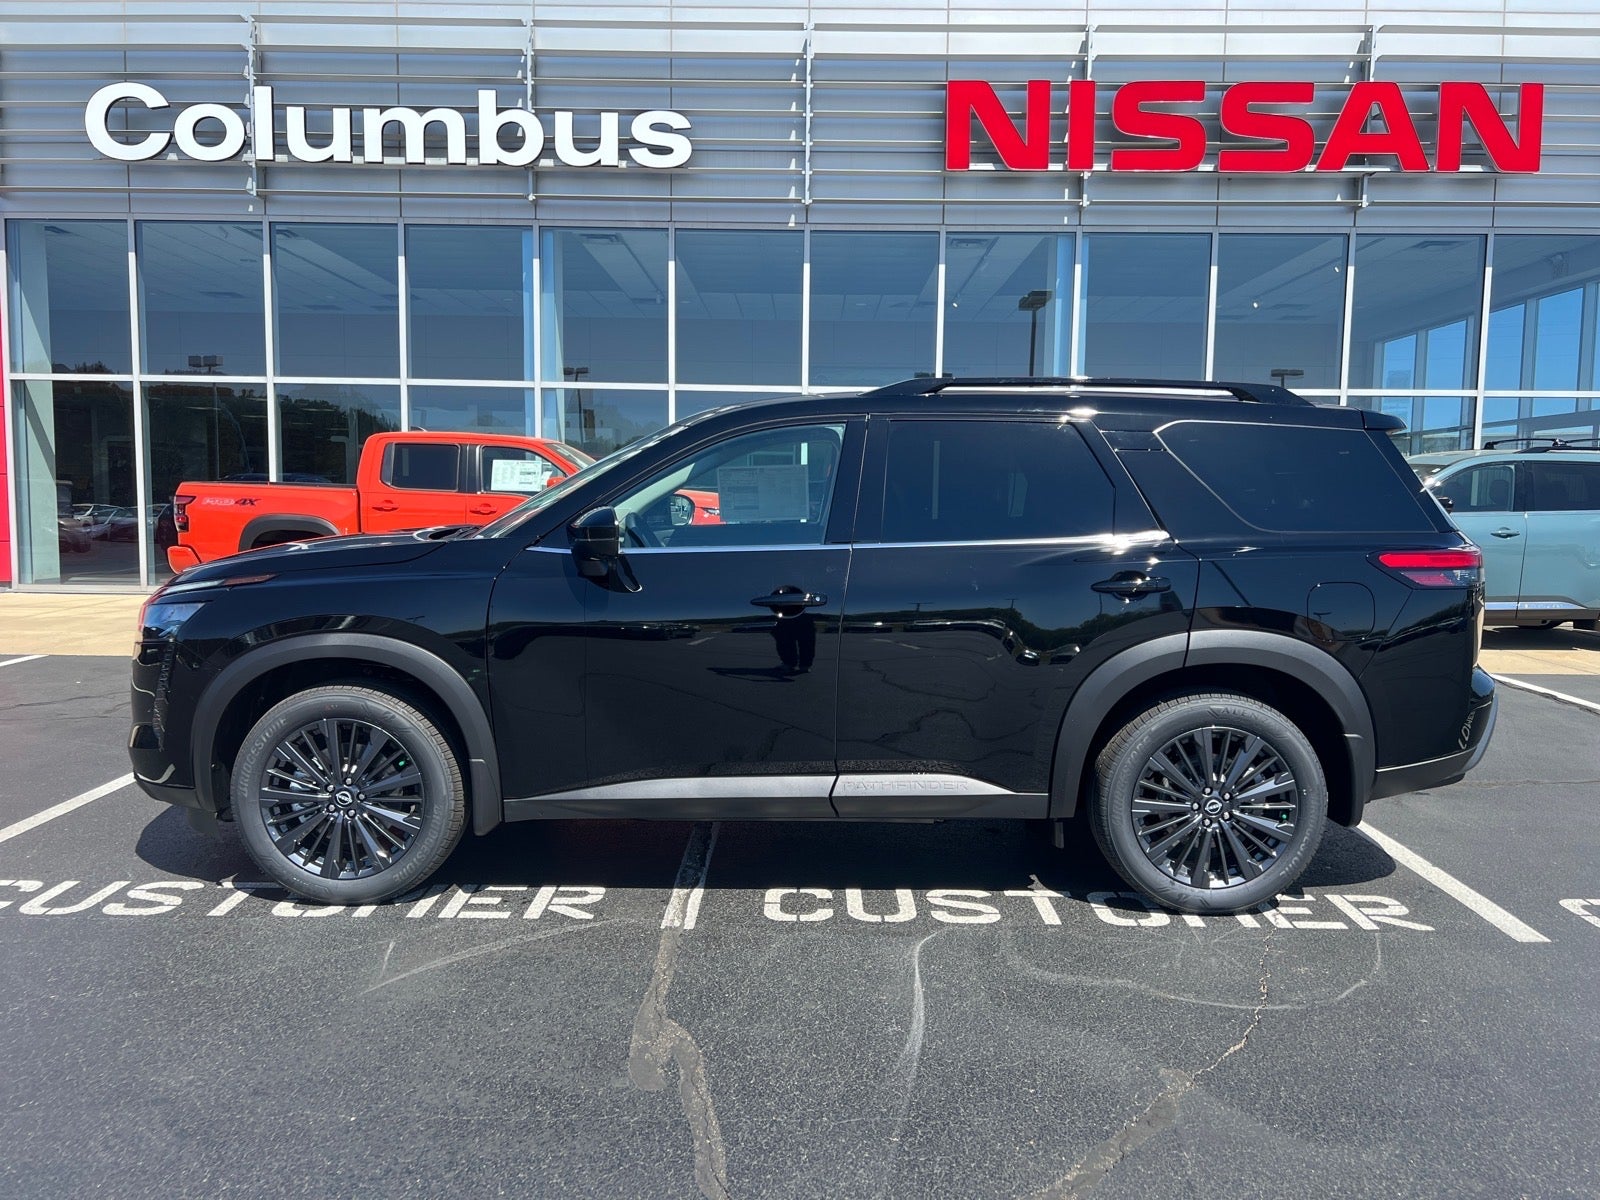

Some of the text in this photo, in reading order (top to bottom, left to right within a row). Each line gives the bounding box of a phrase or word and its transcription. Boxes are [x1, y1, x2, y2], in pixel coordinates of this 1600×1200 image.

[85, 82, 692, 168] Columbus
[946, 80, 1544, 173] NISSAN
[842, 780, 969, 792] PATHFINDER
